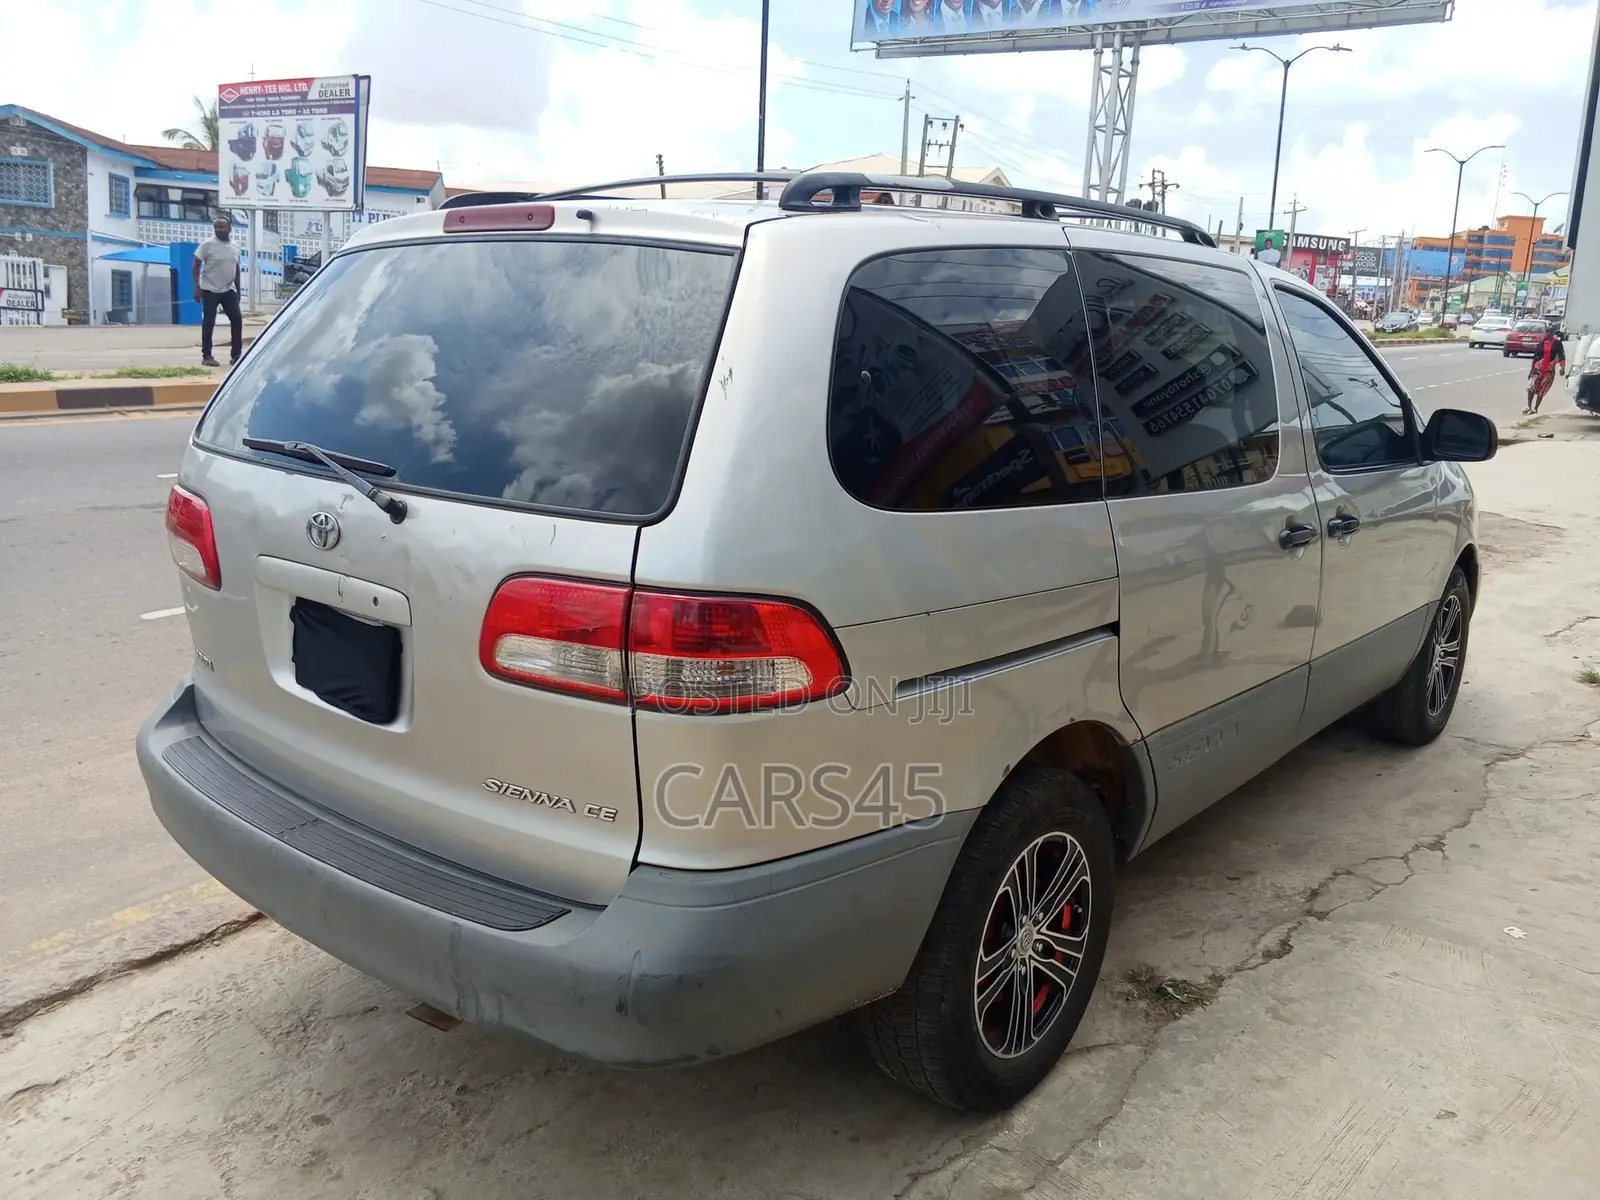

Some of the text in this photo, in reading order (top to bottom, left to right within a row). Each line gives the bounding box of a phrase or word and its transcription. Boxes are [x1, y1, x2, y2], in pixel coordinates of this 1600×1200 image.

[294, 82, 310, 92] LTD.
[318, 89, 351, 98] DEALER
[6, 299, 36, 308] DEALER
[480, 777, 618, 823] SIENNA CE
